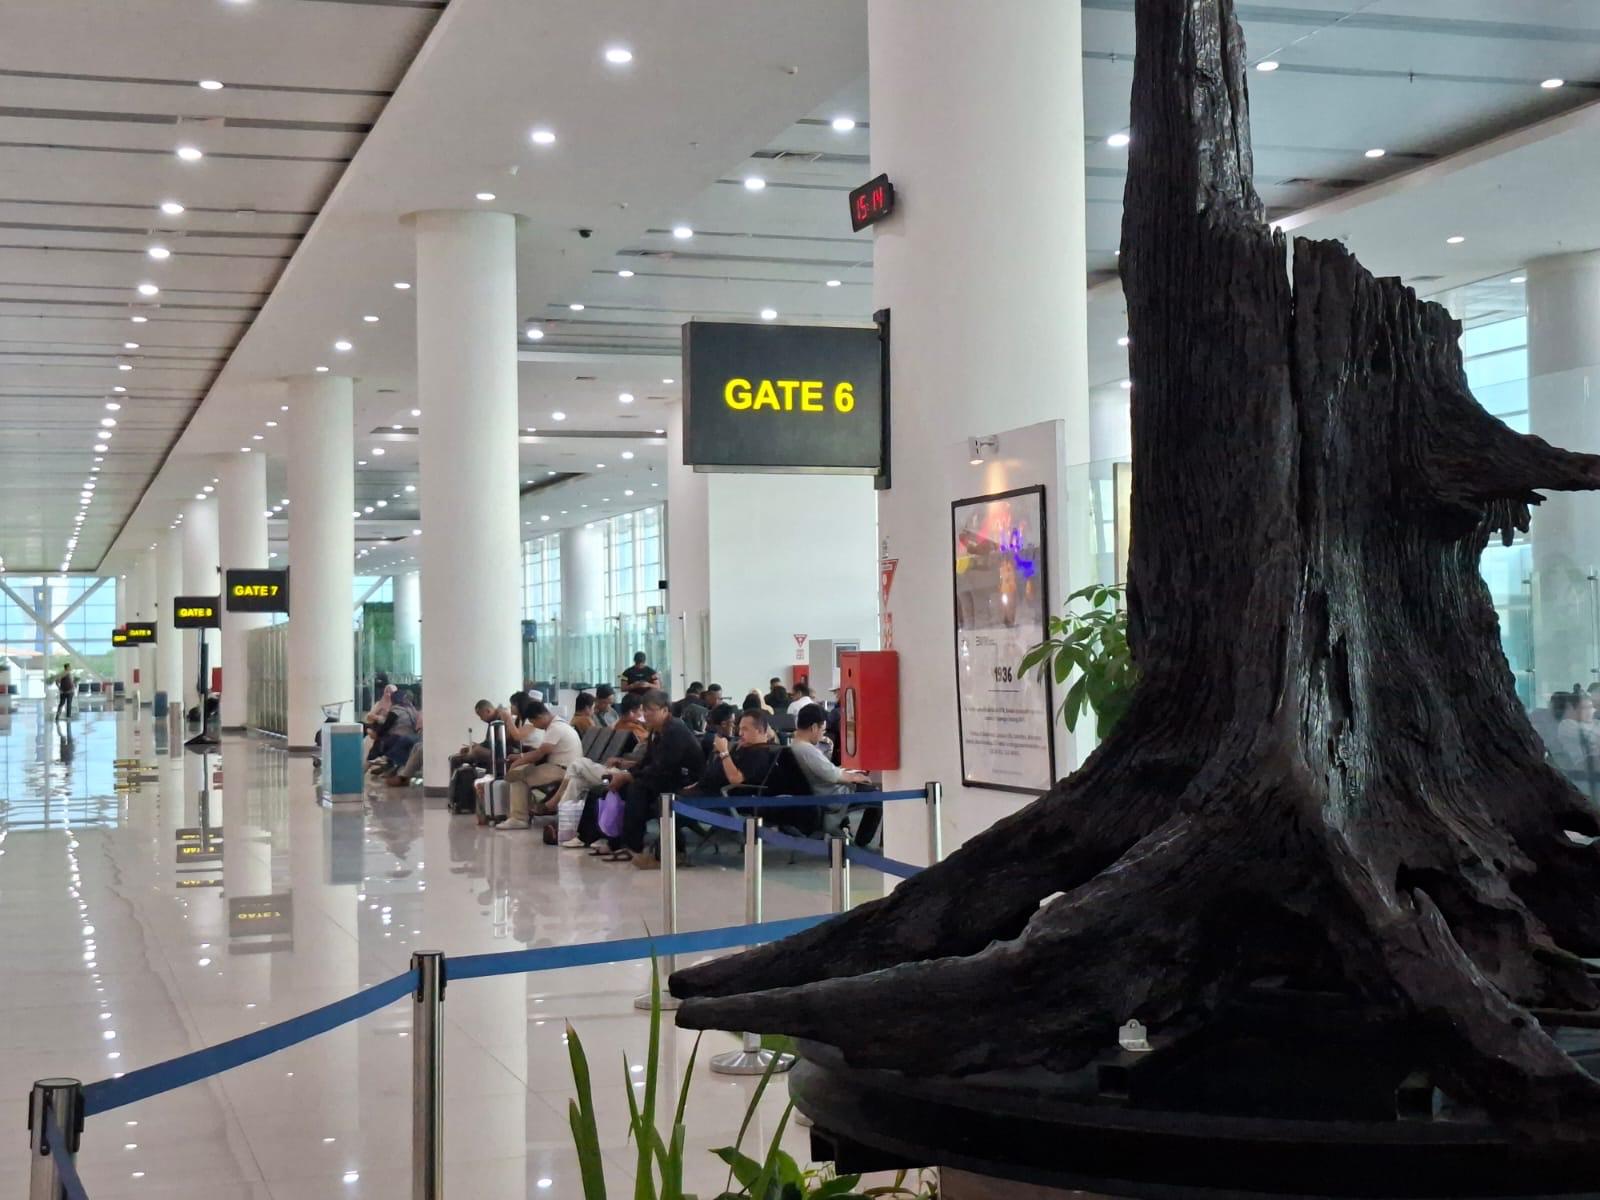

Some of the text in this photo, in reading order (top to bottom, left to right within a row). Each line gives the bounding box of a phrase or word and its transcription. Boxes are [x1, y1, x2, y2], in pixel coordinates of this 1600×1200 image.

[724, 377, 856, 413] GATE 6
[233, 585, 279, 596] GATE 7
[179, 608, 205, 617] GATE
[994, 666, 1013, 683] 1936
